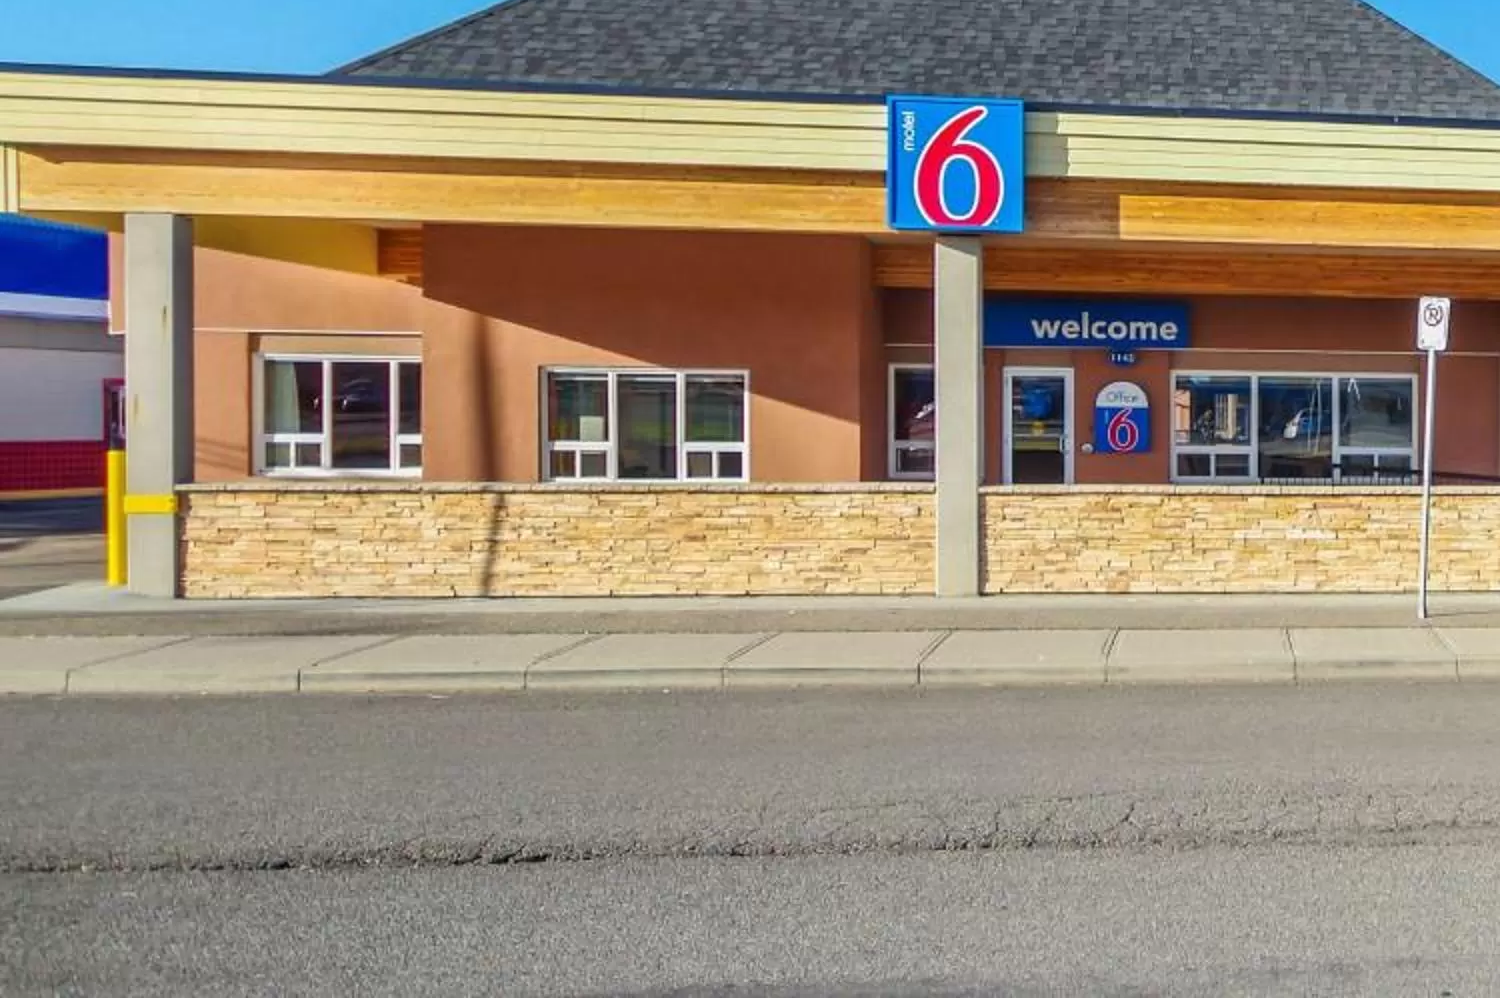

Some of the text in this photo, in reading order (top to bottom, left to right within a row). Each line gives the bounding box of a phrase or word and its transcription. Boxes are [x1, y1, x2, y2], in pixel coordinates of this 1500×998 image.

[902, 105, 1005, 227] motel 6
[1031, 311, 1178, 340] welcome
[1107, 406, 1139, 452] 6
